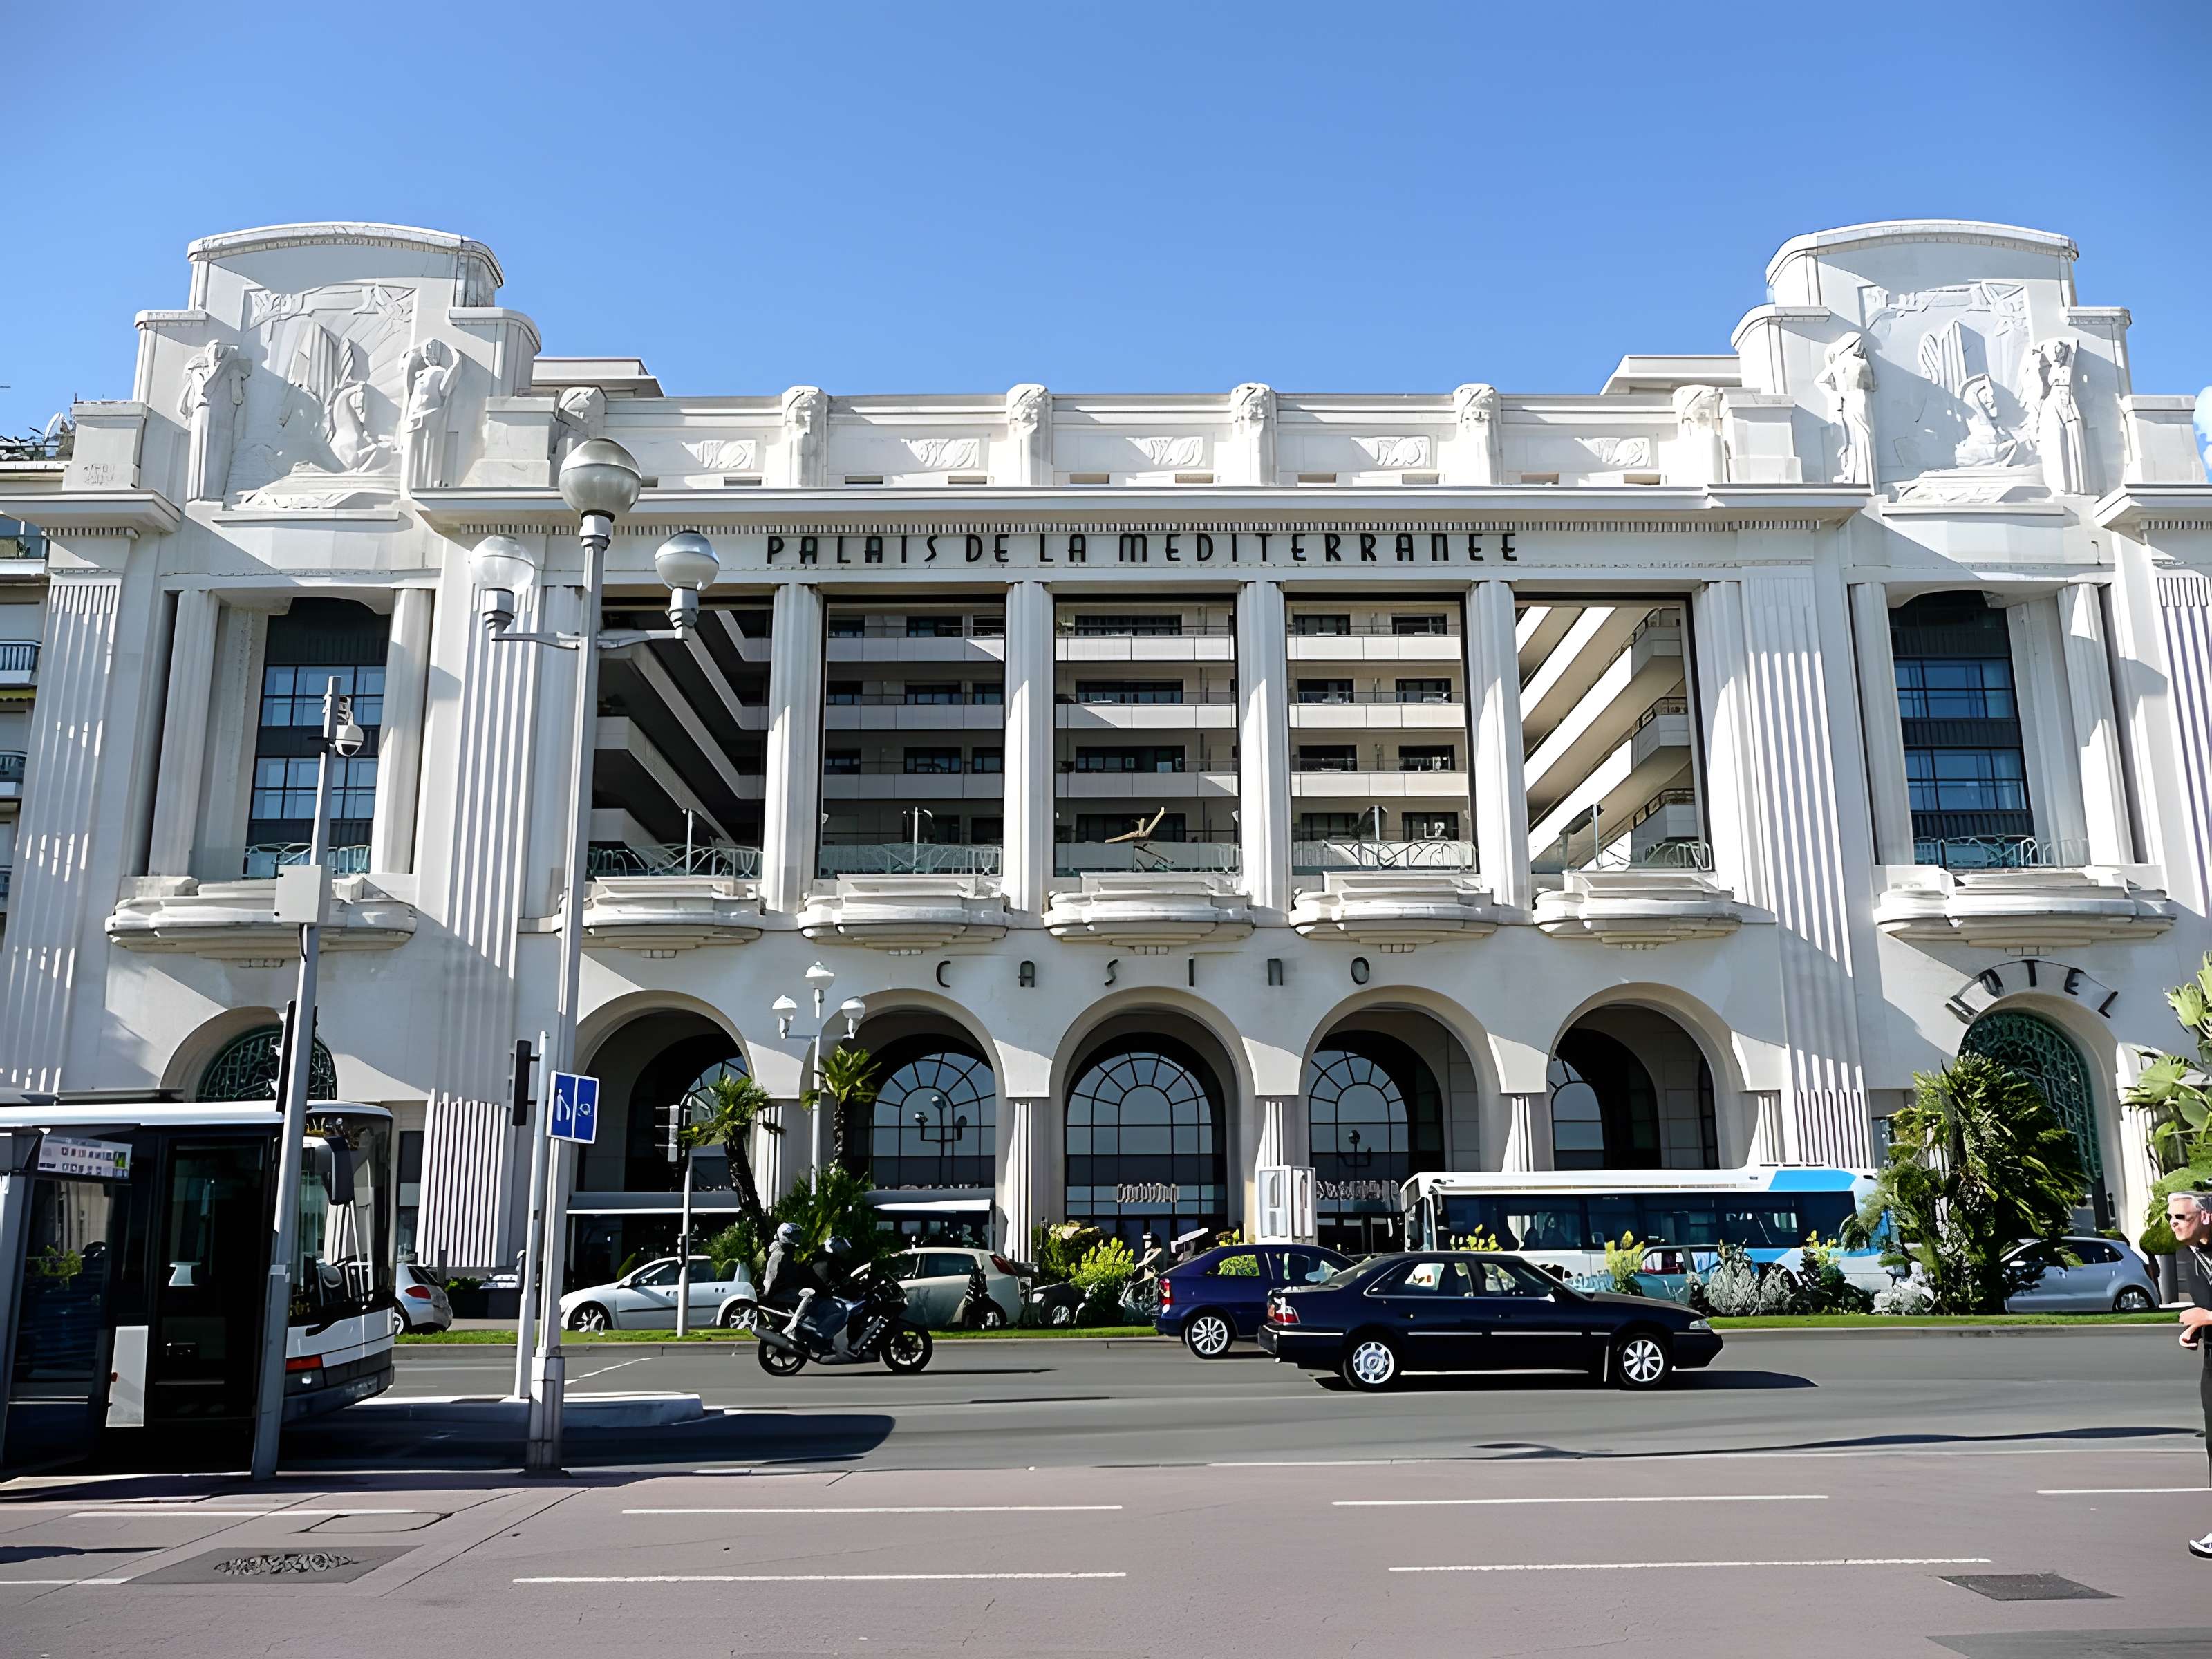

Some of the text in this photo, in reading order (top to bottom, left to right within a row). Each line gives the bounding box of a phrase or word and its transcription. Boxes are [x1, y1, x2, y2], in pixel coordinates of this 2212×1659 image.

[767, 532, 1518, 564] PALAIS DE LA MEDITERRANEE
[936, 957, 1371, 988] CASINO
